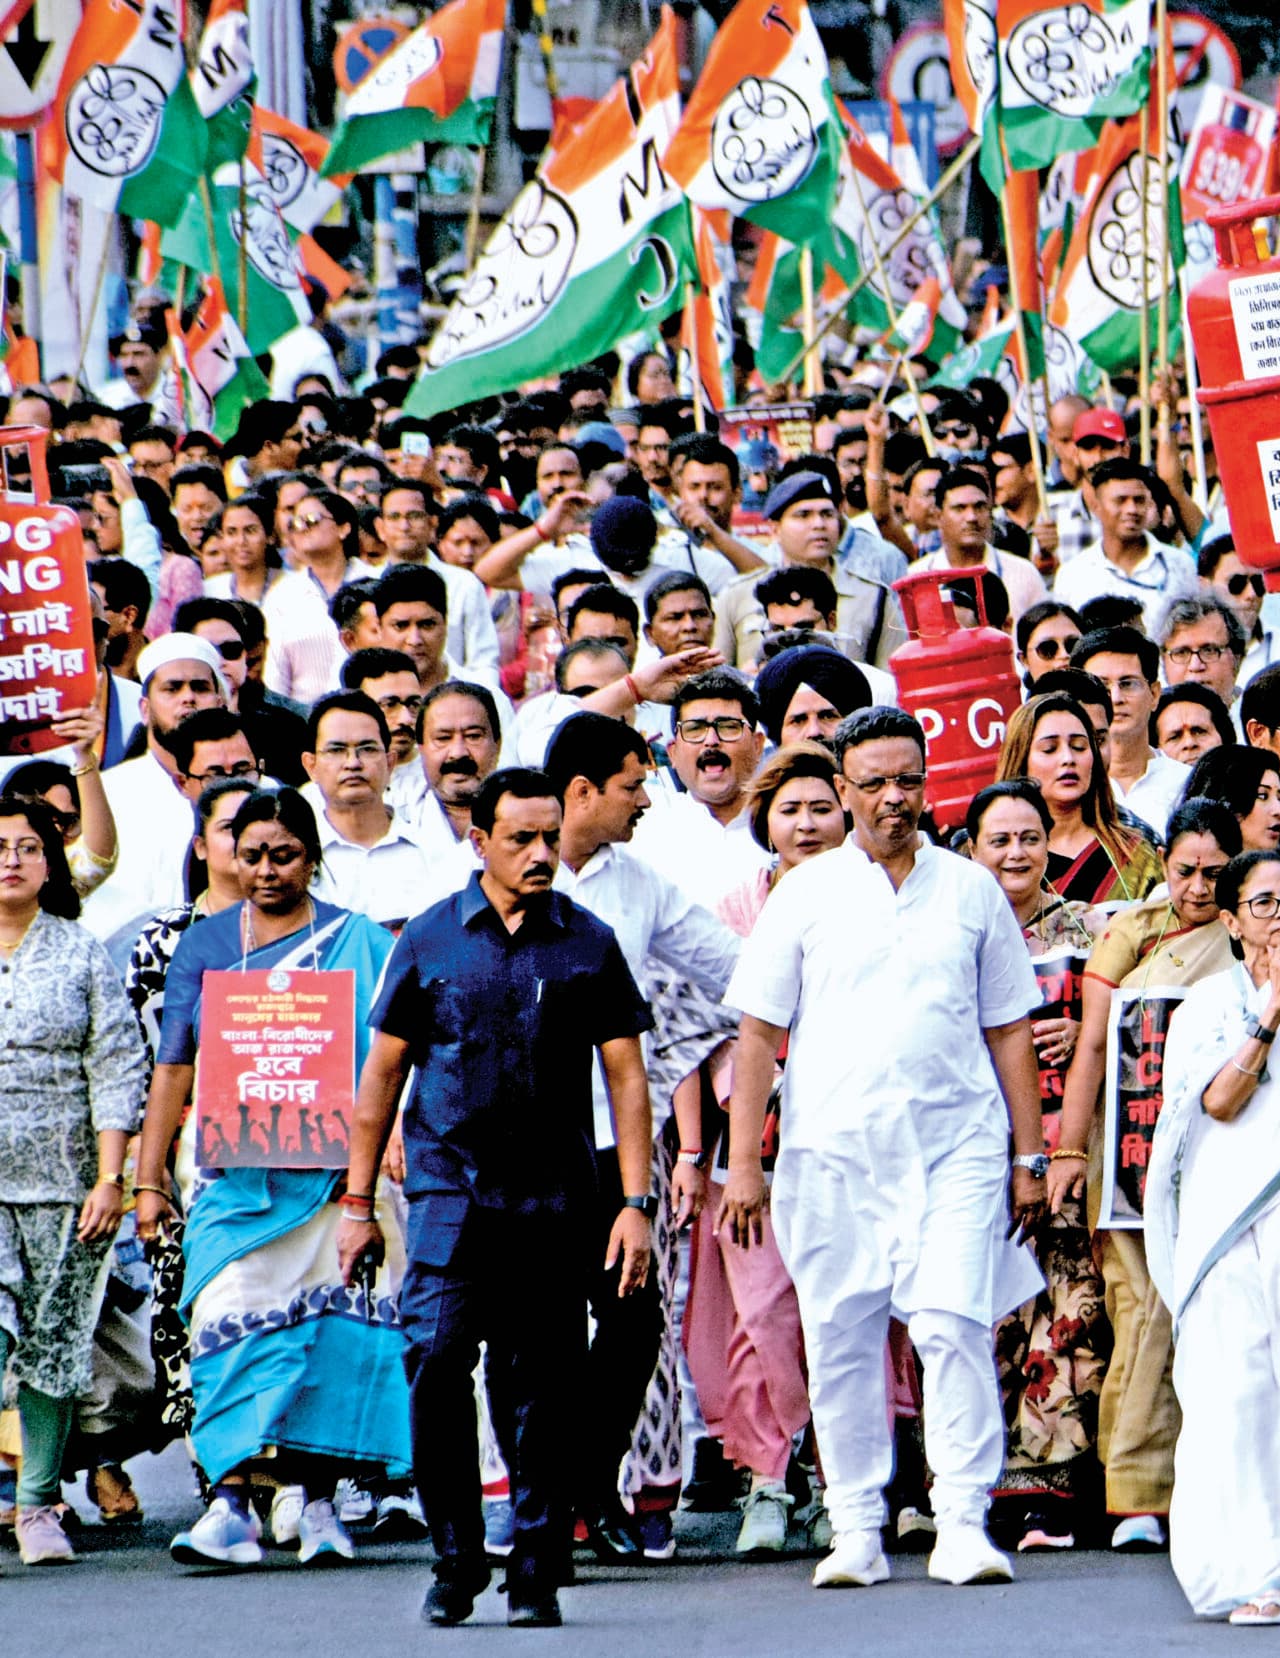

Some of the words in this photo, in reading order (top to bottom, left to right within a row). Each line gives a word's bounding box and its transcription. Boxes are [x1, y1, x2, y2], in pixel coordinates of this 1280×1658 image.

[8, 600, 73, 637] নাই
[253, 1057, 304, 1076] হবে
[237, 1071, 320, 1104] বিচার
